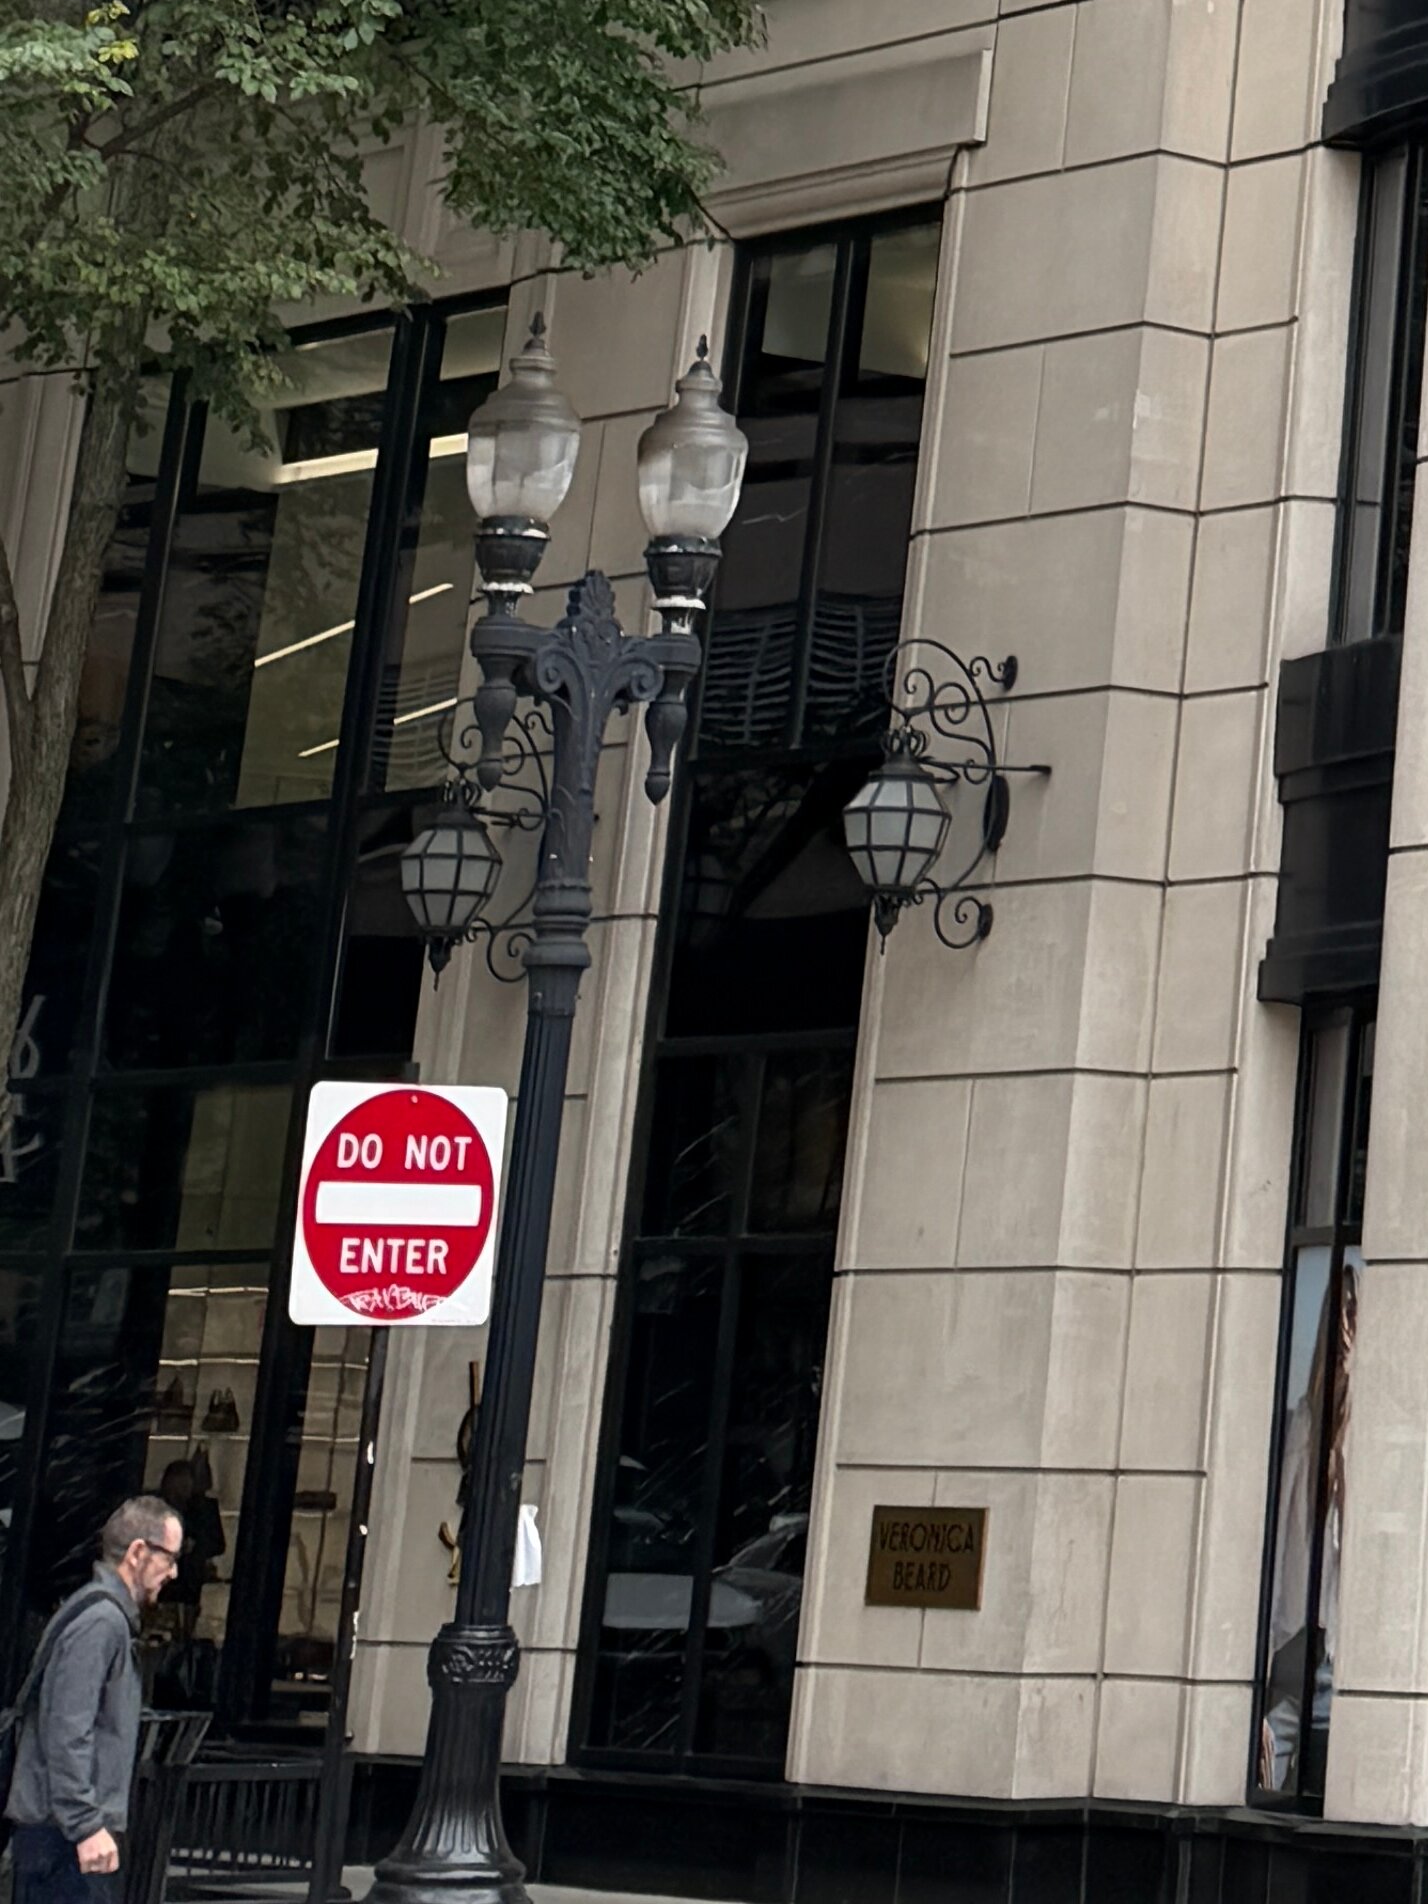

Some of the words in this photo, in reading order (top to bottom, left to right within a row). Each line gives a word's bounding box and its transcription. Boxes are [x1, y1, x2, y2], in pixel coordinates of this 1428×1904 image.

[336, 1132, 384, 1169] DO
[404, 1134, 472, 1171] NOT
[339, 1237, 449, 1275] ENTER
[879, 1521, 974, 1553] VERONICA
[892, 1561, 952, 1591] BEARD
